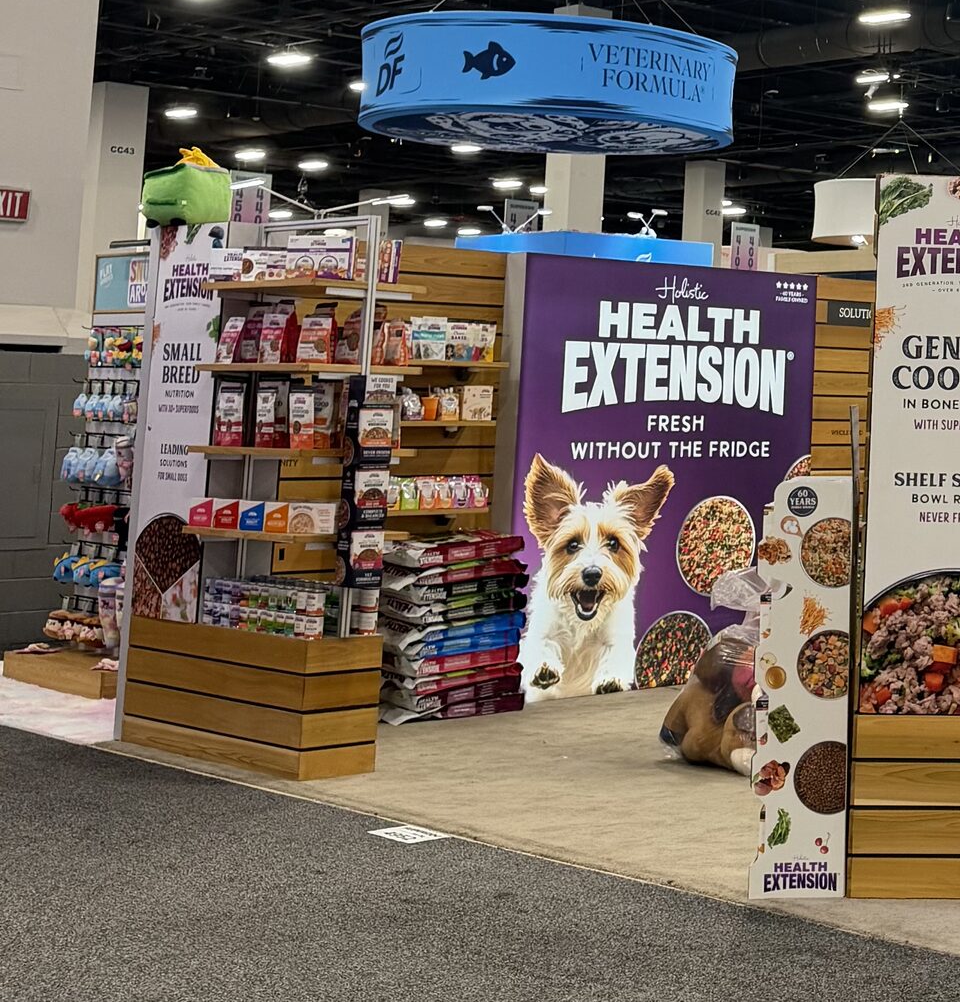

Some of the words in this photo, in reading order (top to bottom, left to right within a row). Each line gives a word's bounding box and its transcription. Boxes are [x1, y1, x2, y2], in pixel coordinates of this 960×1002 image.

[587, 42, 712, 83] VETERINARY
[375, 54, 406, 97] DF
[110, 145, 135, 155] CC43
[172, 262, 209, 277] HEALTH
[655, 276, 709, 303] Holistic
[599, 300, 761, 345] HEALTH
[162, 343, 202, 362] SMALL
[161, 366, 200, 385] BREED
[164, 390, 194, 399] NUTRITION
[903, 398, 916, 409] IN
[921, 399, 960, 410] BONE
[647, 414, 705, 432] FRESH
[914, 419, 939, 431] WITH
[160, 443, 189, 456] LEADING
[571, 441, 661, 460] WITHOUT
[669, 441, 702, 458] THE
[709, 441, 770, 458] FRIDGE
[159, 459, 188, 468] SOLUTIONS
[894, 472, 948, 487] SHELF
[797, 489, 808, 498] 60
[911, 494, 949, 504] BOWL
[790, 497, 816, 506] YEARS
[919, 511, 950, 523] NEVER
[774, 861, 828, 872] HEALTH
